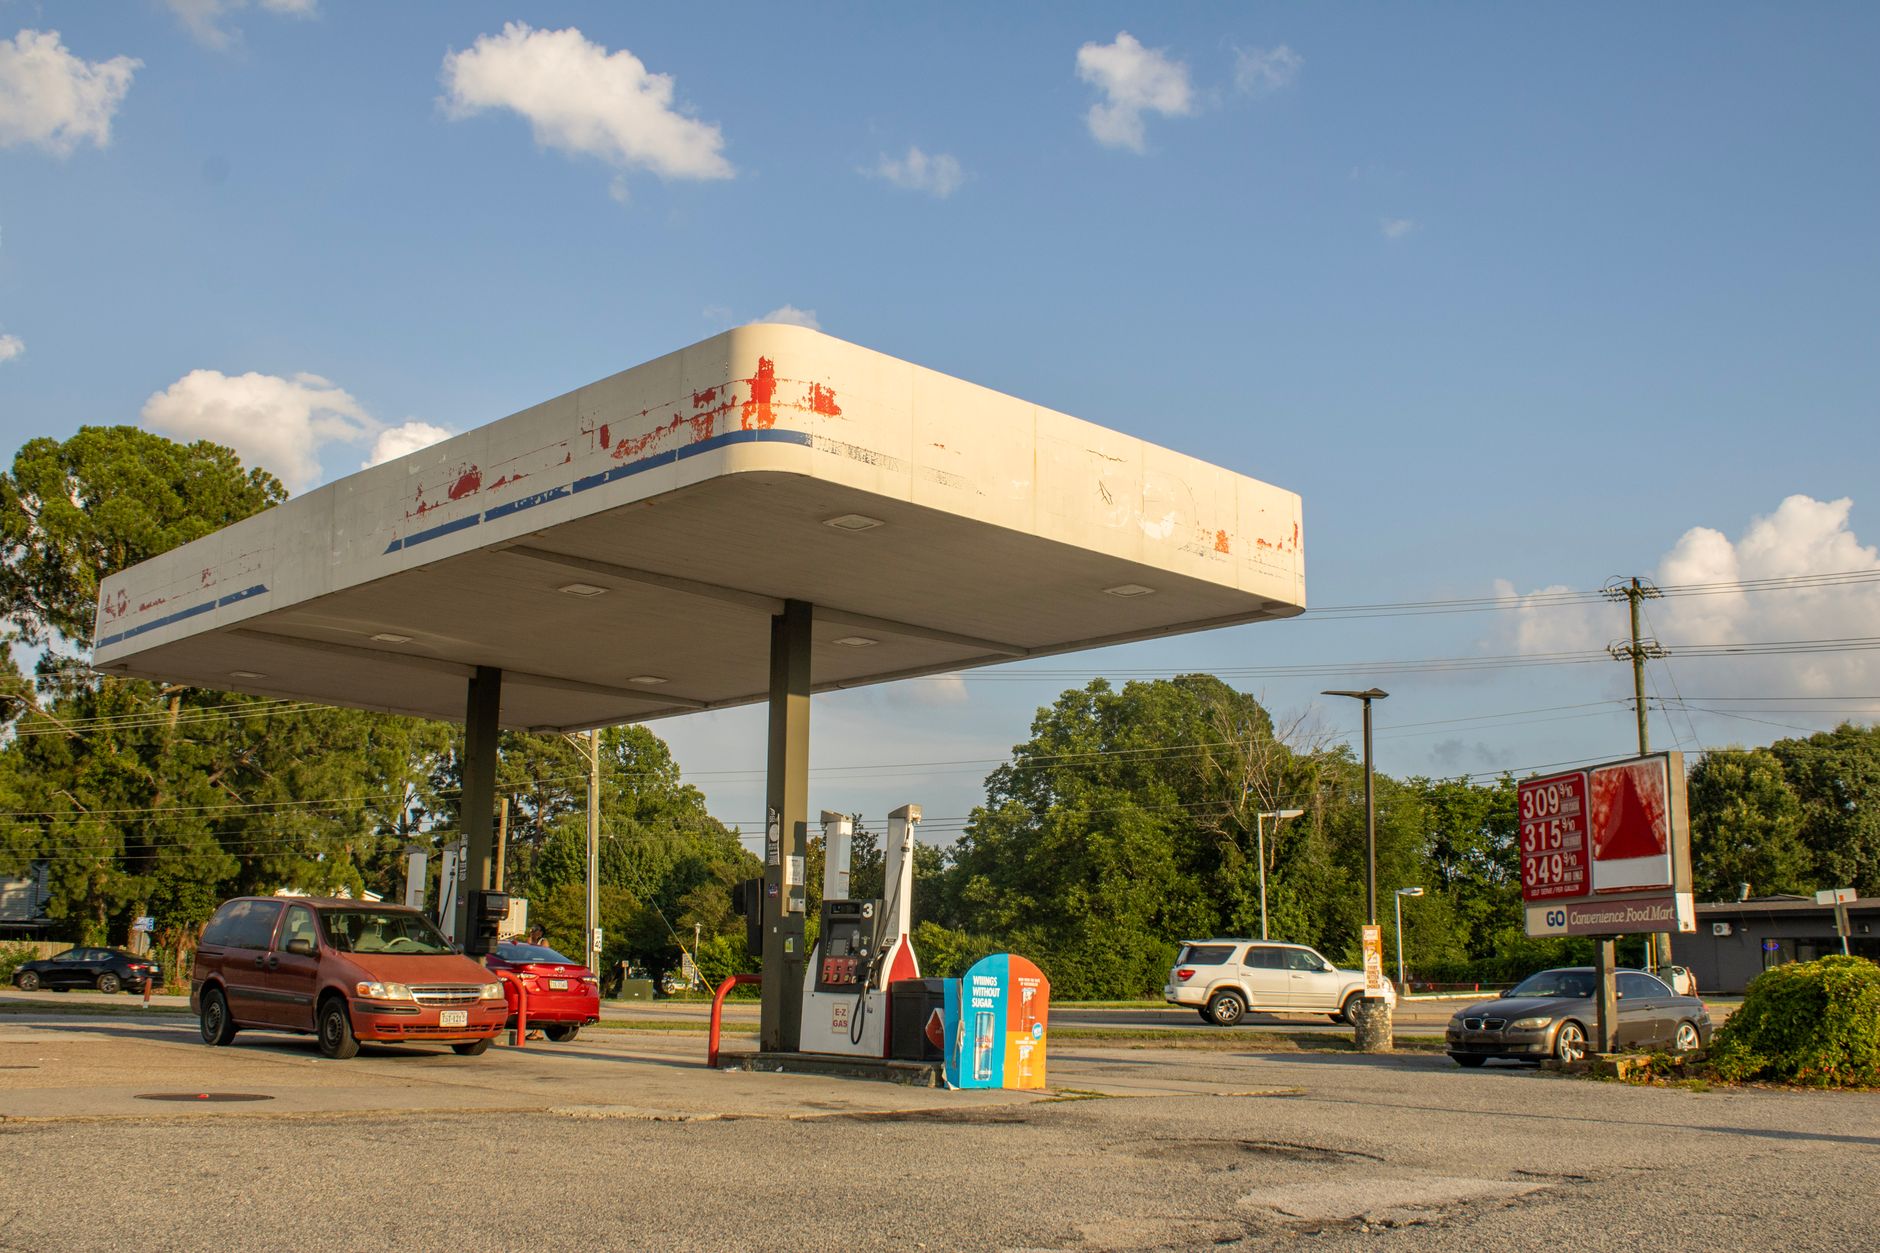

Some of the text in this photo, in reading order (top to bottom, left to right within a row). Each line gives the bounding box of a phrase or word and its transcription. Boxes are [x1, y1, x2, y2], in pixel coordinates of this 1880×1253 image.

[1523, 783, 1573, 819] 309 9/10
[1525, 820, 1561, 852] 315
[1562, 816, 1576, 832] 9/10
[1526, 850, 1577, 886] 349 9/10
[862, 903, 874, 918] 3
[1546, 904, 1674, 927] GO Convenience Food Mart
[971, 997, 995, 1009] SUGAR.
[972, 986, 1001, 998] WITHOUT
